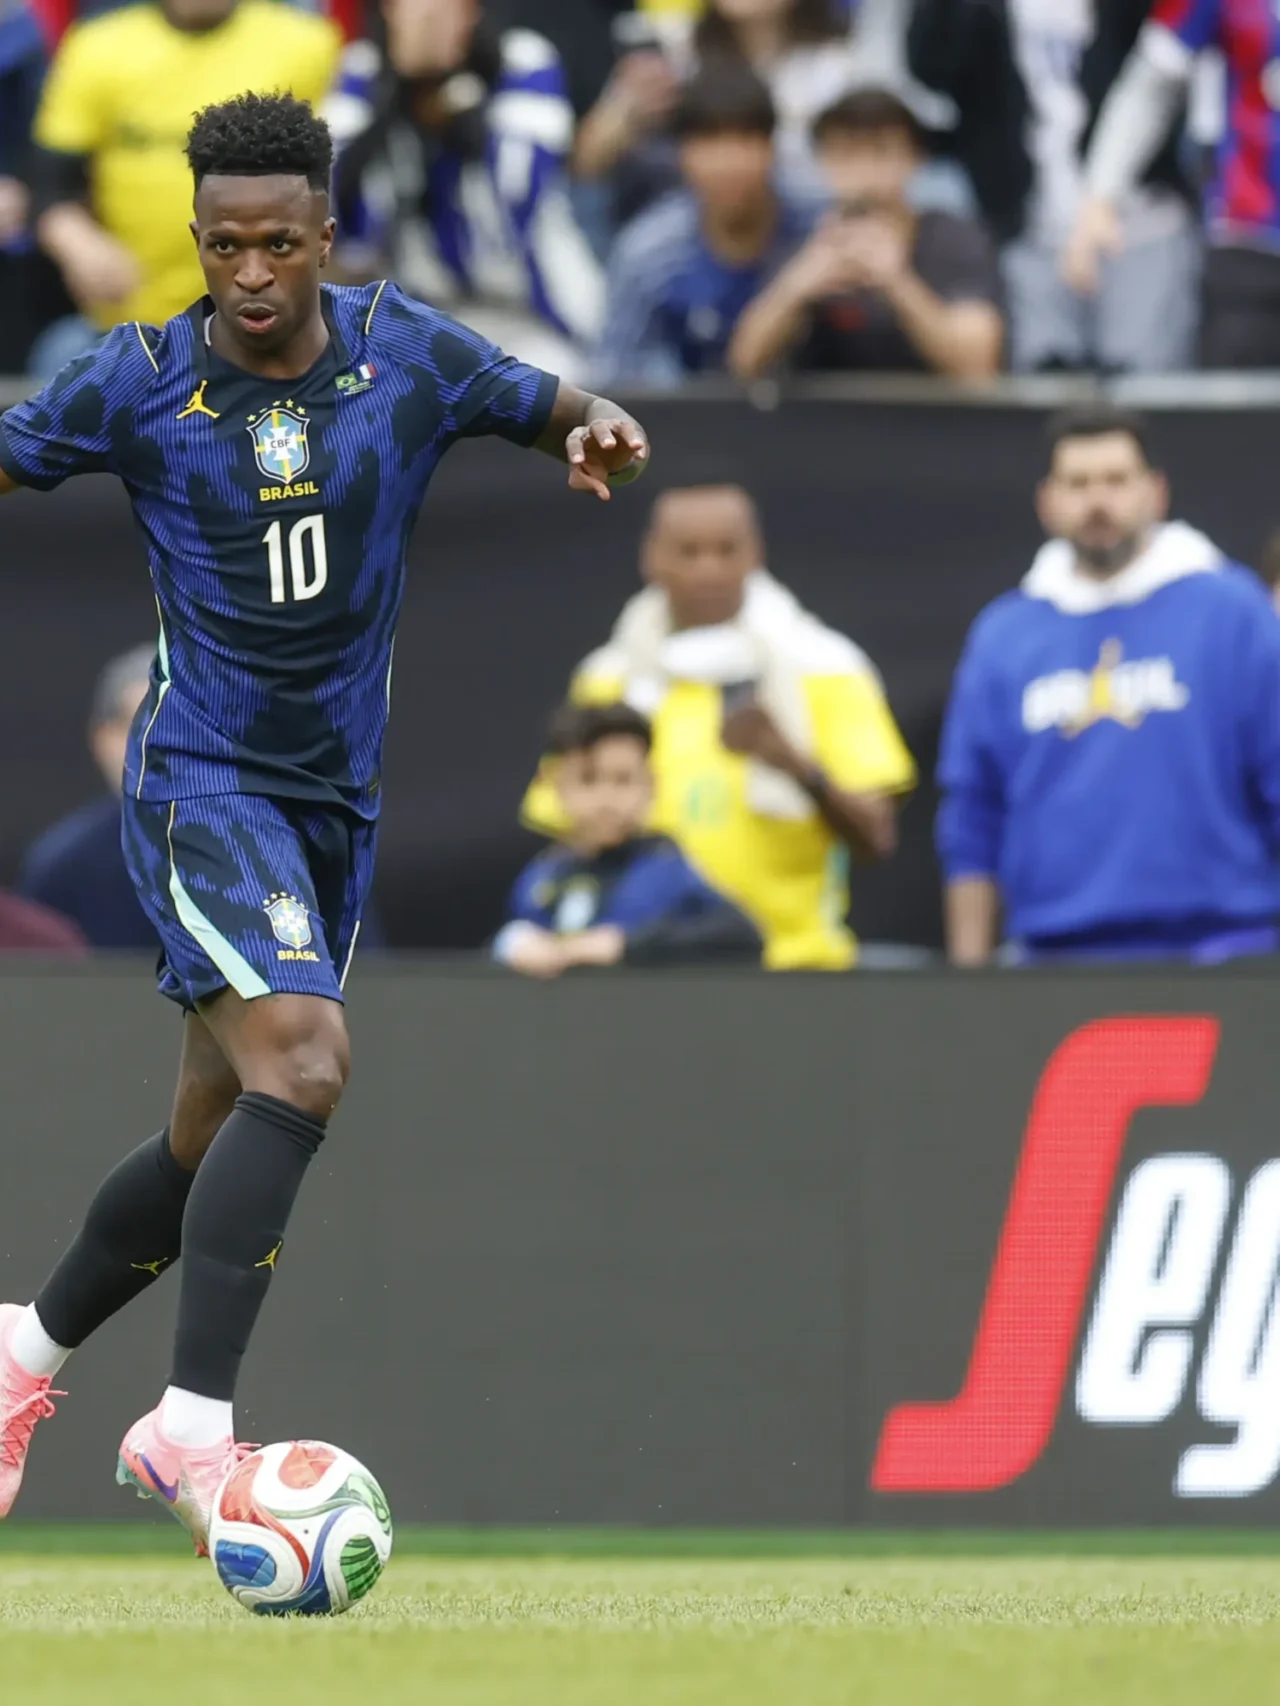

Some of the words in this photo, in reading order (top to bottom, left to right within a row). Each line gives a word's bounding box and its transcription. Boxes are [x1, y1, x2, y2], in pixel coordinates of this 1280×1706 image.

[270, 438, 291, 449] CBF
[259, 480, 320, 502] BRASIL
[261, 513, 328, 604] 10
[276, 949, 320, 962] BRASIL
[870, 1015, 1280, 1497] Seg
